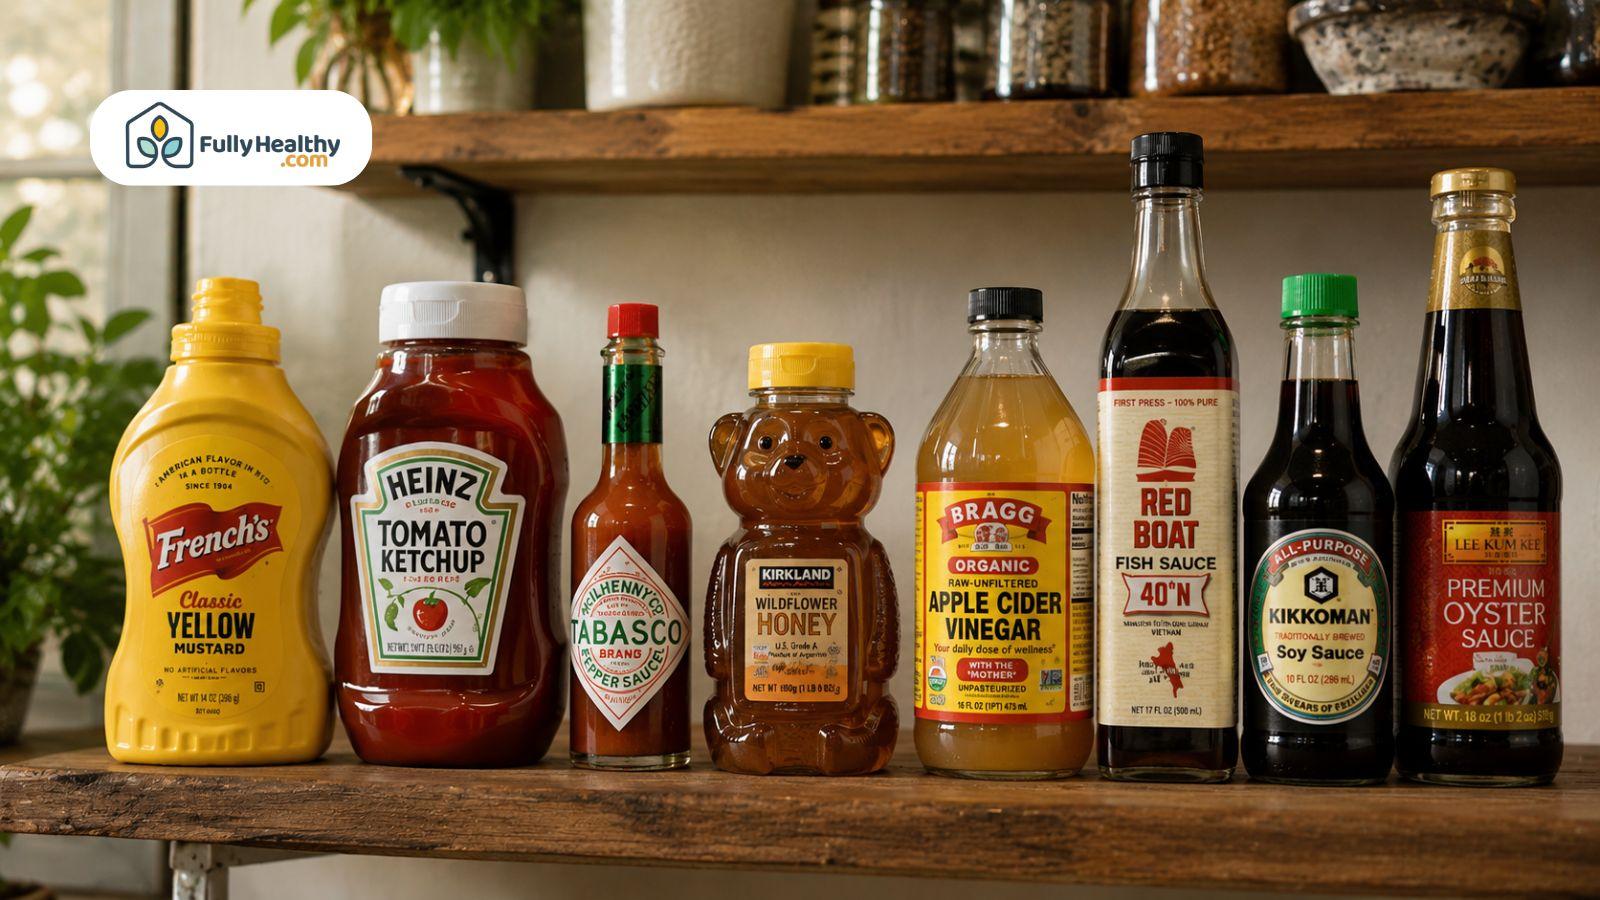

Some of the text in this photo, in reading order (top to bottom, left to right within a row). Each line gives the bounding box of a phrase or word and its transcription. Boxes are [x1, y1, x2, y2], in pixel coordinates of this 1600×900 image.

[1114, 399, 1136, 407] FIRST
[1138, 399, 1165, 407] PRESS
[1174, 399, 1195, 407] 100%
[1197, 398, 1219, 407] PURE
[206, 454, 242, 468] FLAVOR
[200, 467, 237, 478] BOTTLE
[185, 482, 233, 490] SINCE 1904
[386, 466, 478, 501] HEINZ
[1141, 487, 1192, 517] RED
[950, 501, 1036, 525] BRAGG
[378, 520, 487, 547] TOMATO
[1133, 520, 1200, 549] BOAT
[157, 514, 269, 571] French's
[1455, 539, 1541, 550] LEE KUM KEE
[381, 549, 485, 573] KETCHUP
[1274, 539, 1370, 566] ALL-PURPOSE
[955, 559, 1031, 573] ORGANIC
[1115, 556, 1217, 570] FISH SAUCE
[762, 568, 832, 580] KIRKLAND
[948, 579, 1039, 588] RAW-UNFILTERED
[1448, 579, 1545, 598] PREMIUM
[179, 590, 243, 609] Classic
[755, 597, 838, 610] WILDFLOWER
[928, 591, 1062, 614] APPLE CIDER
[1269, 608, 1371, 625] KIKKOMAN
[1443, 601, 1546, 625] OYSTER
[167, 612, 255, 639] YELLOW
[571, 619, 682, 646] TABASCO
[757, 612, 837, 636] HONEY
[945, 618, 1041, 641] VINEGAR
[1333, 632, 1365, 641] BREWED
[1461, 628, 1535, 648] SAUCE
[174, 643, 246, 655] MUSTARD
[812, 642, 818, 650] A
[933, 643, 950, 653] Your
[952, 643, 973, 655] daily
[975, 645, 999, 653] dose
[1001, 643, 1012, 654] of
[1277, 645, 1364, 662] Soy Sauce
[968, 661, 1014, 670] WITH THE
[958, 684, 1027, 693] UNPASTEURIZED
[1131, 706, 1144, 714] NET
[1423, 708, 1441, 720] NET
[1443, 709, 1463, 722] WT.
[1464, 711, 1477, 722] 18
